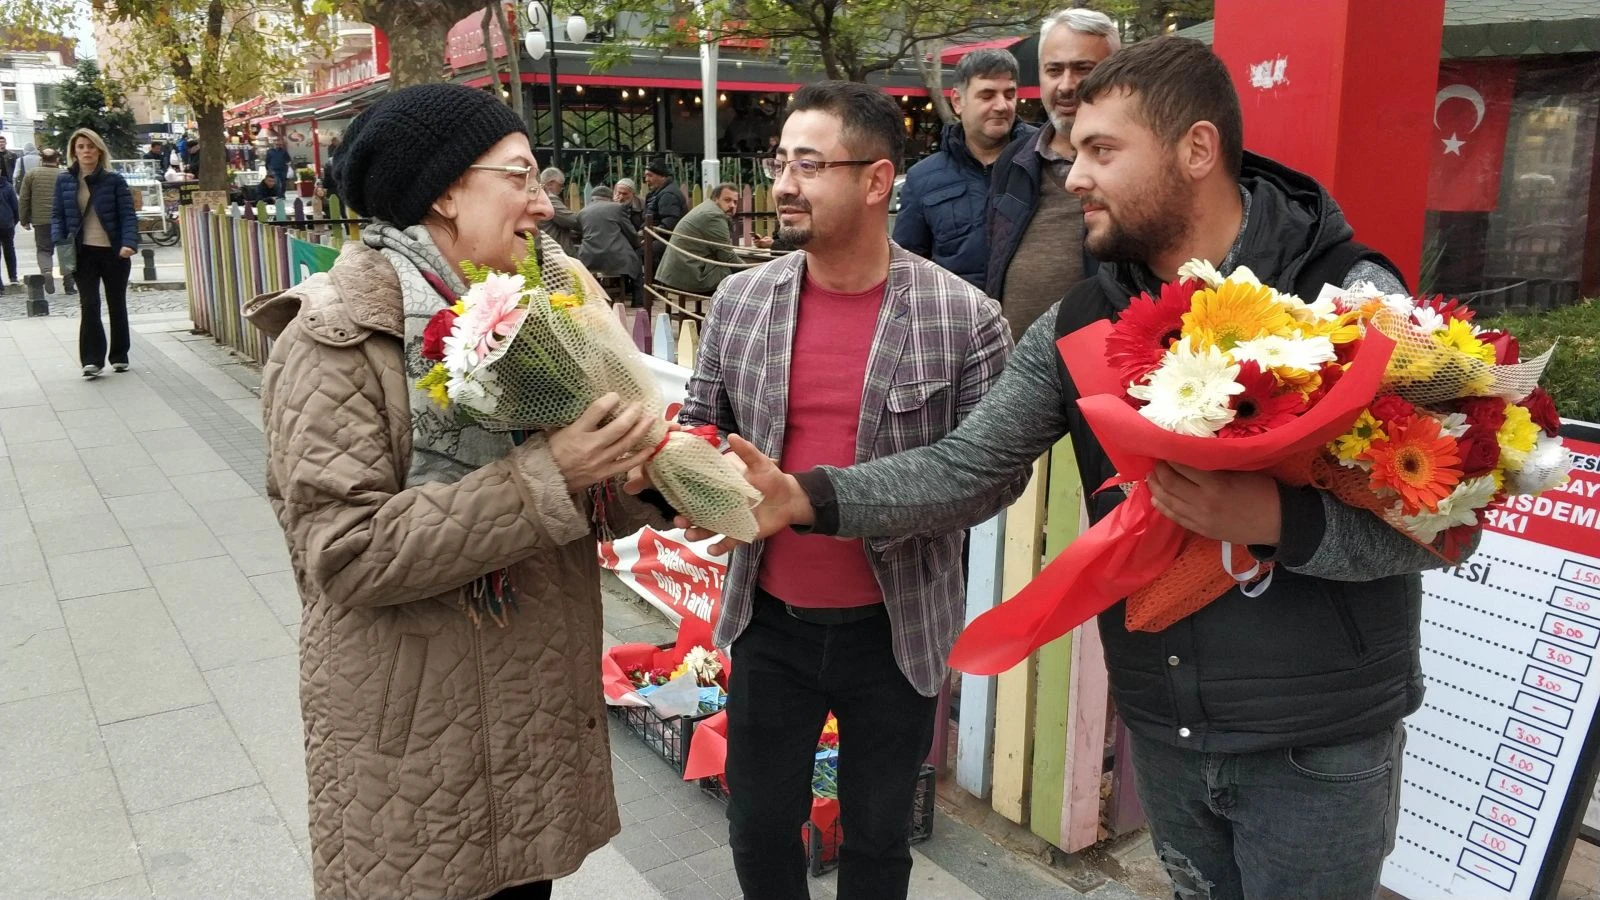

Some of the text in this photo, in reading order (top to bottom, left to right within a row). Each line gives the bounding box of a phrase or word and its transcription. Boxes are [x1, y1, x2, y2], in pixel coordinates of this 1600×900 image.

[682, 582, 715, 623] Tarihi
[1564, 596, 1590, 611] 5.00
[1552, 621, 1584, 639] 5.00
[1546, 647, 1573, 665] 3.00
[1536, 674, 1561, 692] 3.00
[1515, 727, 1541, 745] 3.00
[1508, 753, 1534, 772] 1.00
[1500, 779, 1524, 796] 1.50
[1490, 806, 1517, 827] 5.00
[1481, 833, 1506, 852] 1.00
